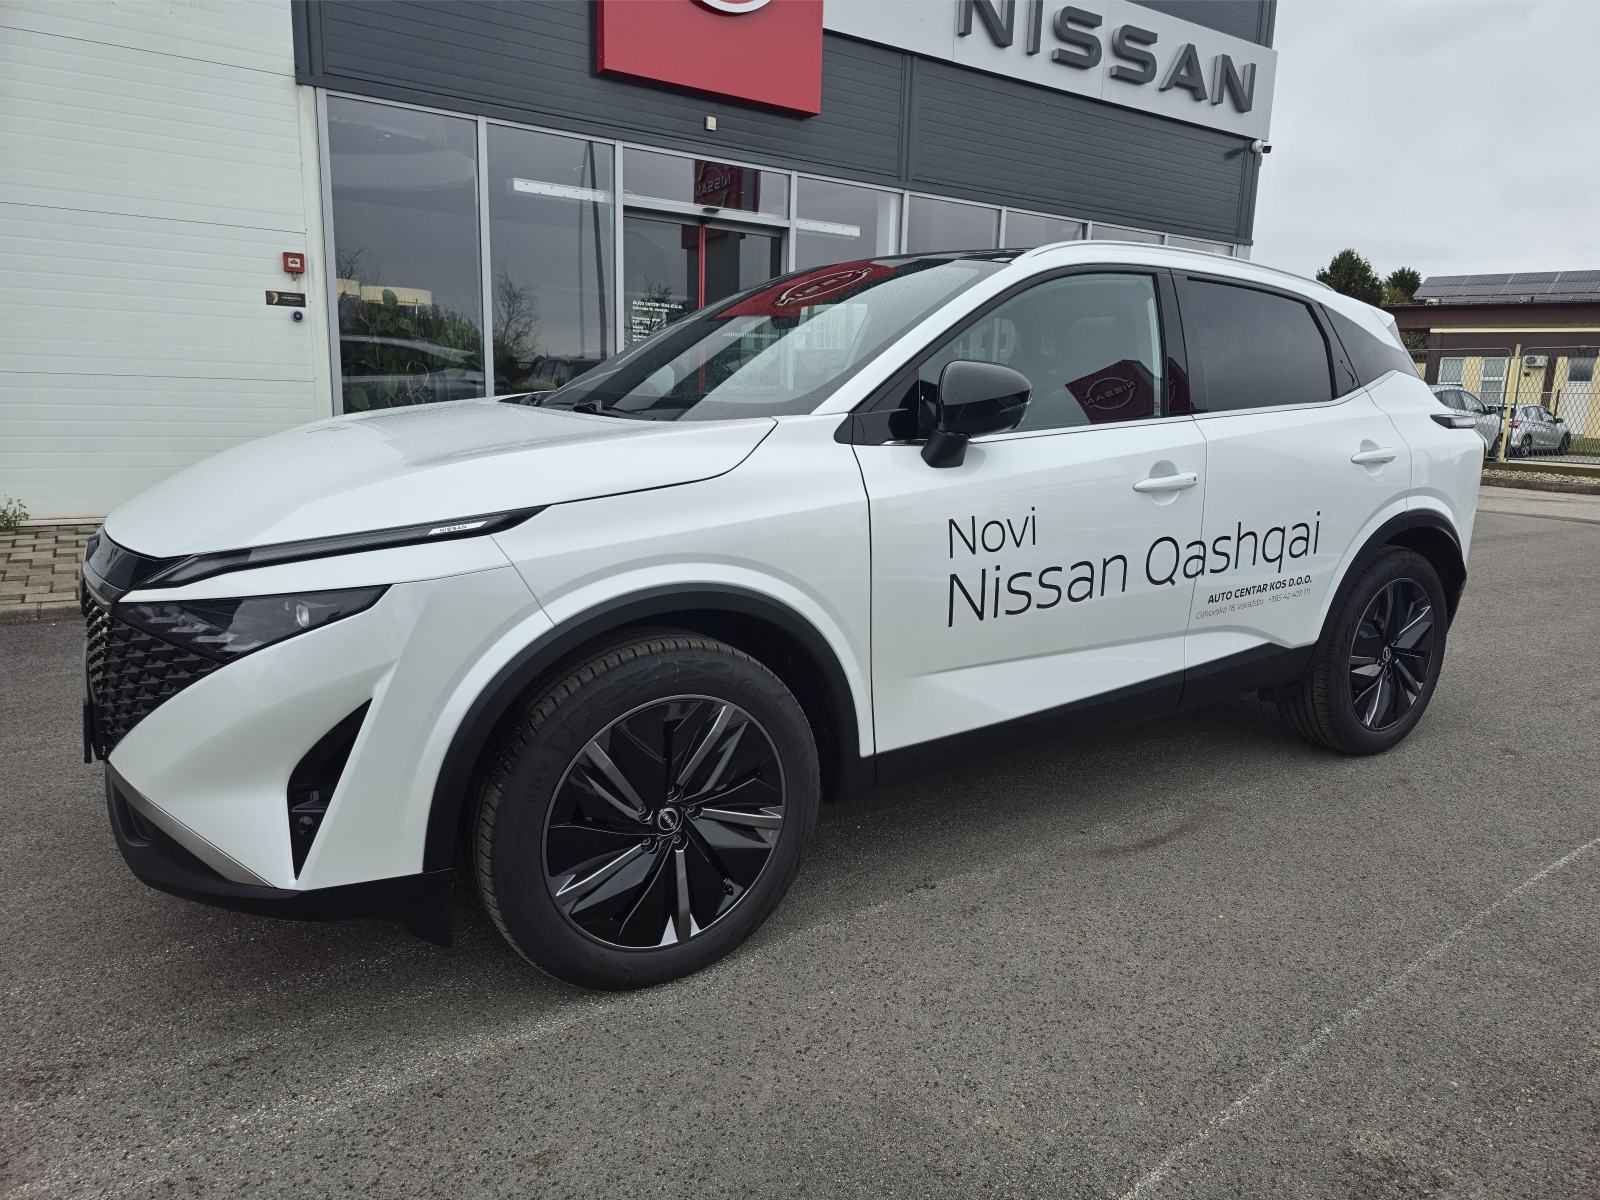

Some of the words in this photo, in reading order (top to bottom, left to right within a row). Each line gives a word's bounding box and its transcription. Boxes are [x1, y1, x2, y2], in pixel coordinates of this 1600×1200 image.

[957, 0, 1257, 113] NISSAN
[440, 524, 467, 533] NISSAN
[948, 507, 1037, 558] Novi
[948, 553, 1128, 628] Nissan
[1145, 511, 1321, 586] Qashqai
[1207, 591, 1232, 604] AUTO
[1234, 583, 1268, 598] CENTAR
[1269, 579, 1287, 591] KOS
[1288, 575, 1312, 587] D.O.O.
